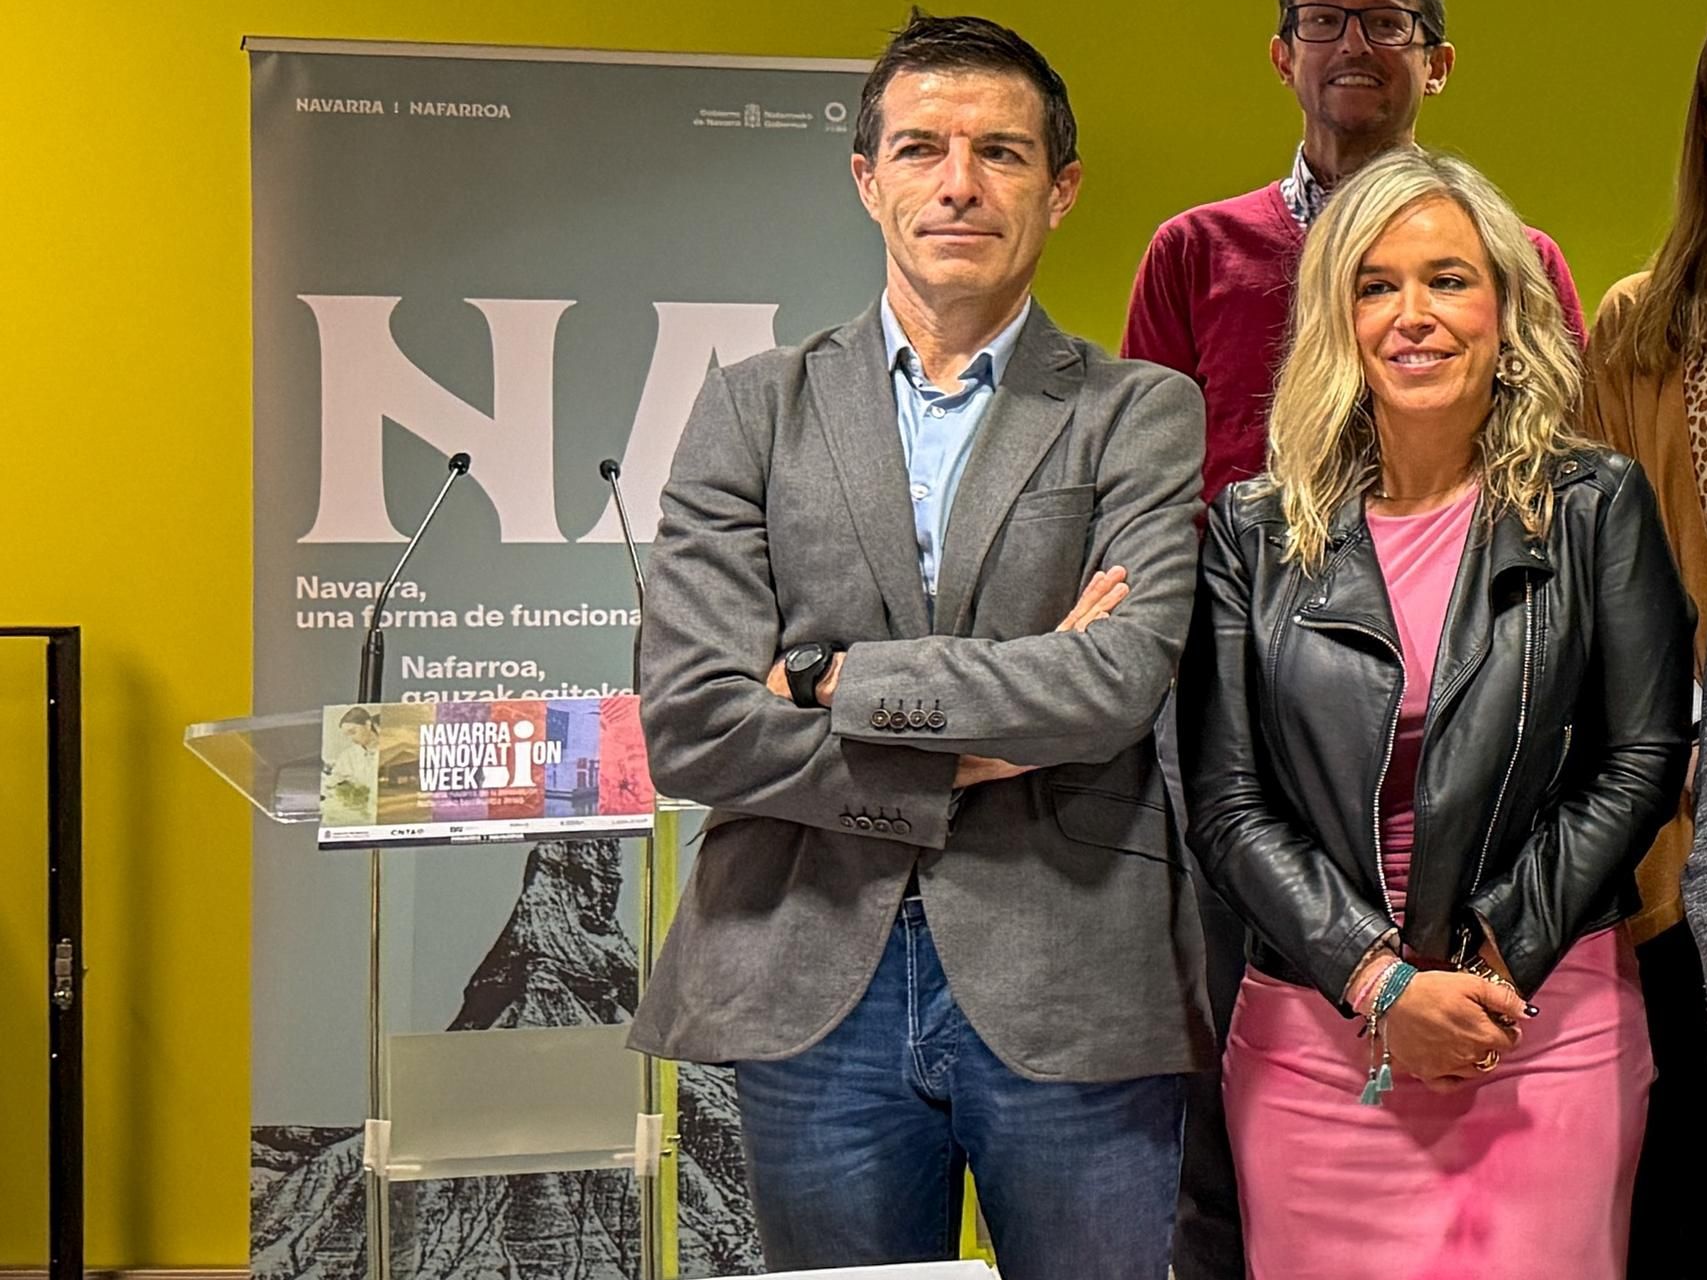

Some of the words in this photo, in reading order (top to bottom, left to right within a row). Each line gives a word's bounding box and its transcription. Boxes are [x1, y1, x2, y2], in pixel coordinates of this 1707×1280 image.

[296, 97, 384, 115] NAVARRA
[409, 101, 511, 118] NAFARROA
[296, 609, 355, 628] una
[361, 604, 457, 629] forma
[464, 604, 504, 628] de
[401, 655, 546, 682] Nafarroa,
[419, 722, 511, 746] NAVARRA
[419, 766, 479, 792] WEEK
